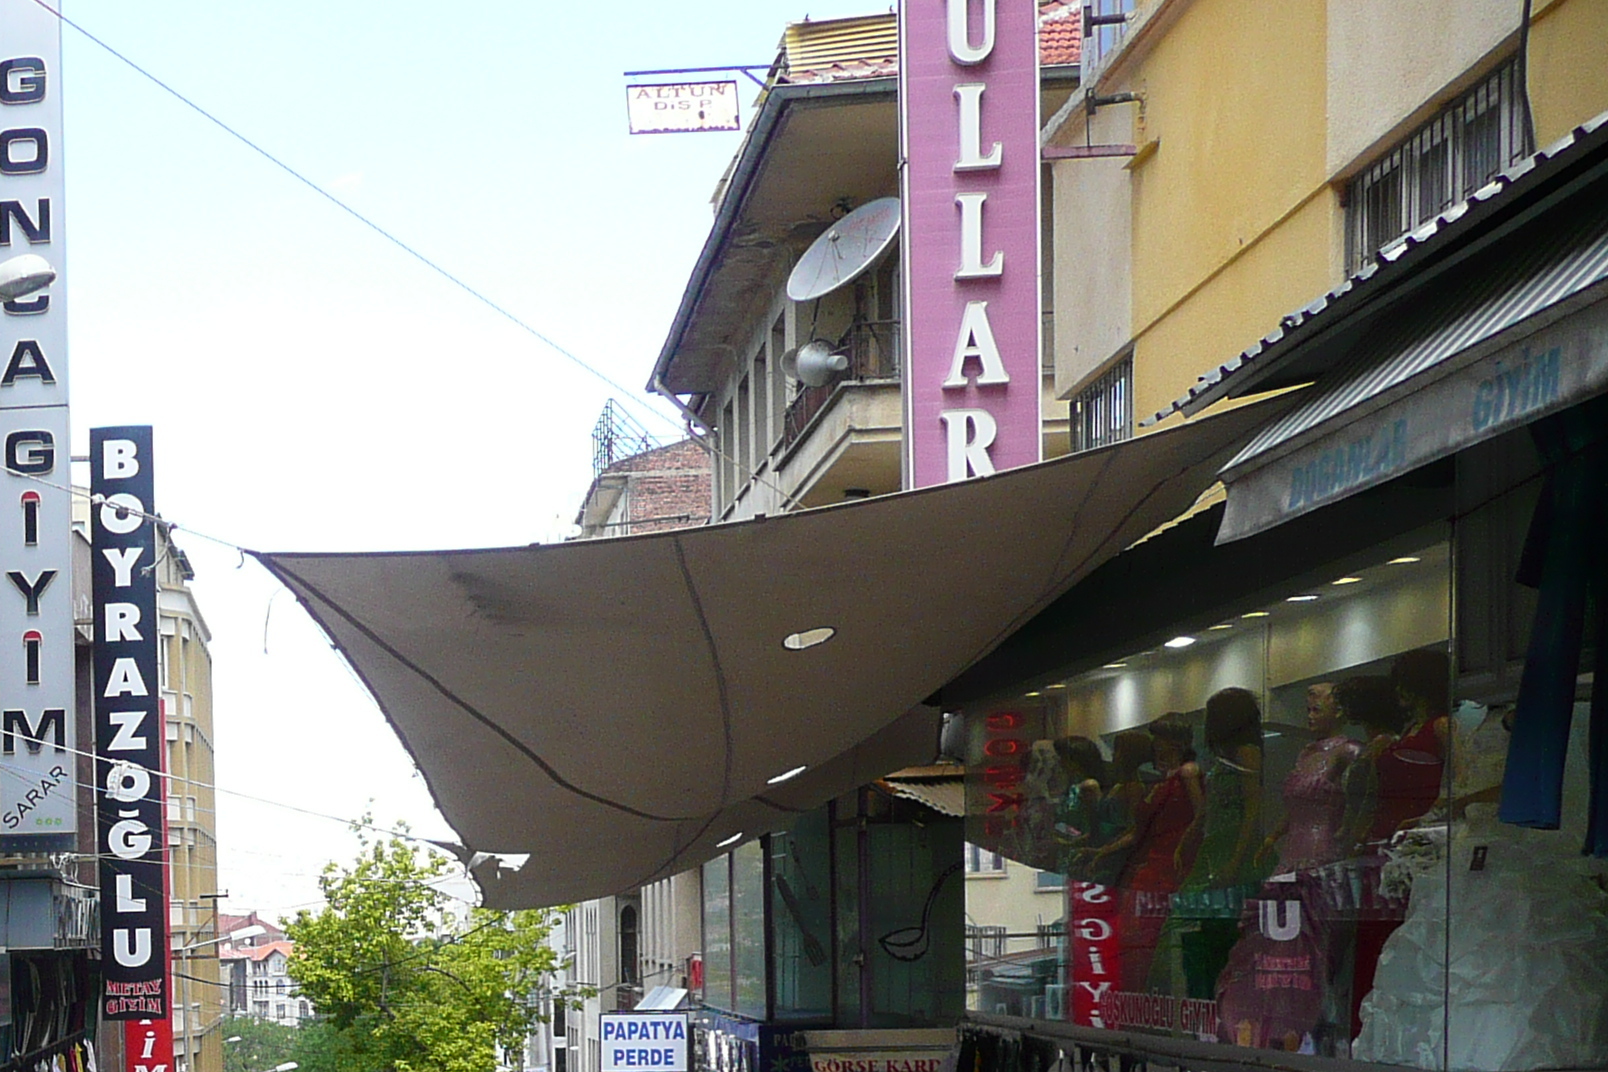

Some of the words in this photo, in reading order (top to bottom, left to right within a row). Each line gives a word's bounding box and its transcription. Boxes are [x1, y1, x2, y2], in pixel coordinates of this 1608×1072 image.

[636, 83, 727, 99] ALTUN
[3, 429, 66, 754] GİYİM
[100, 440, 152, 967] BOYRAZOĞLU
[2, 764, 68, 830] SARAR
[106, 978, 162, 995] METAY
[603, 1020, 685, 1042] PAPATYA
[613, 1048, 675, 1067] PERDE
[814, 1058, 880, 1072] GÖRSE
